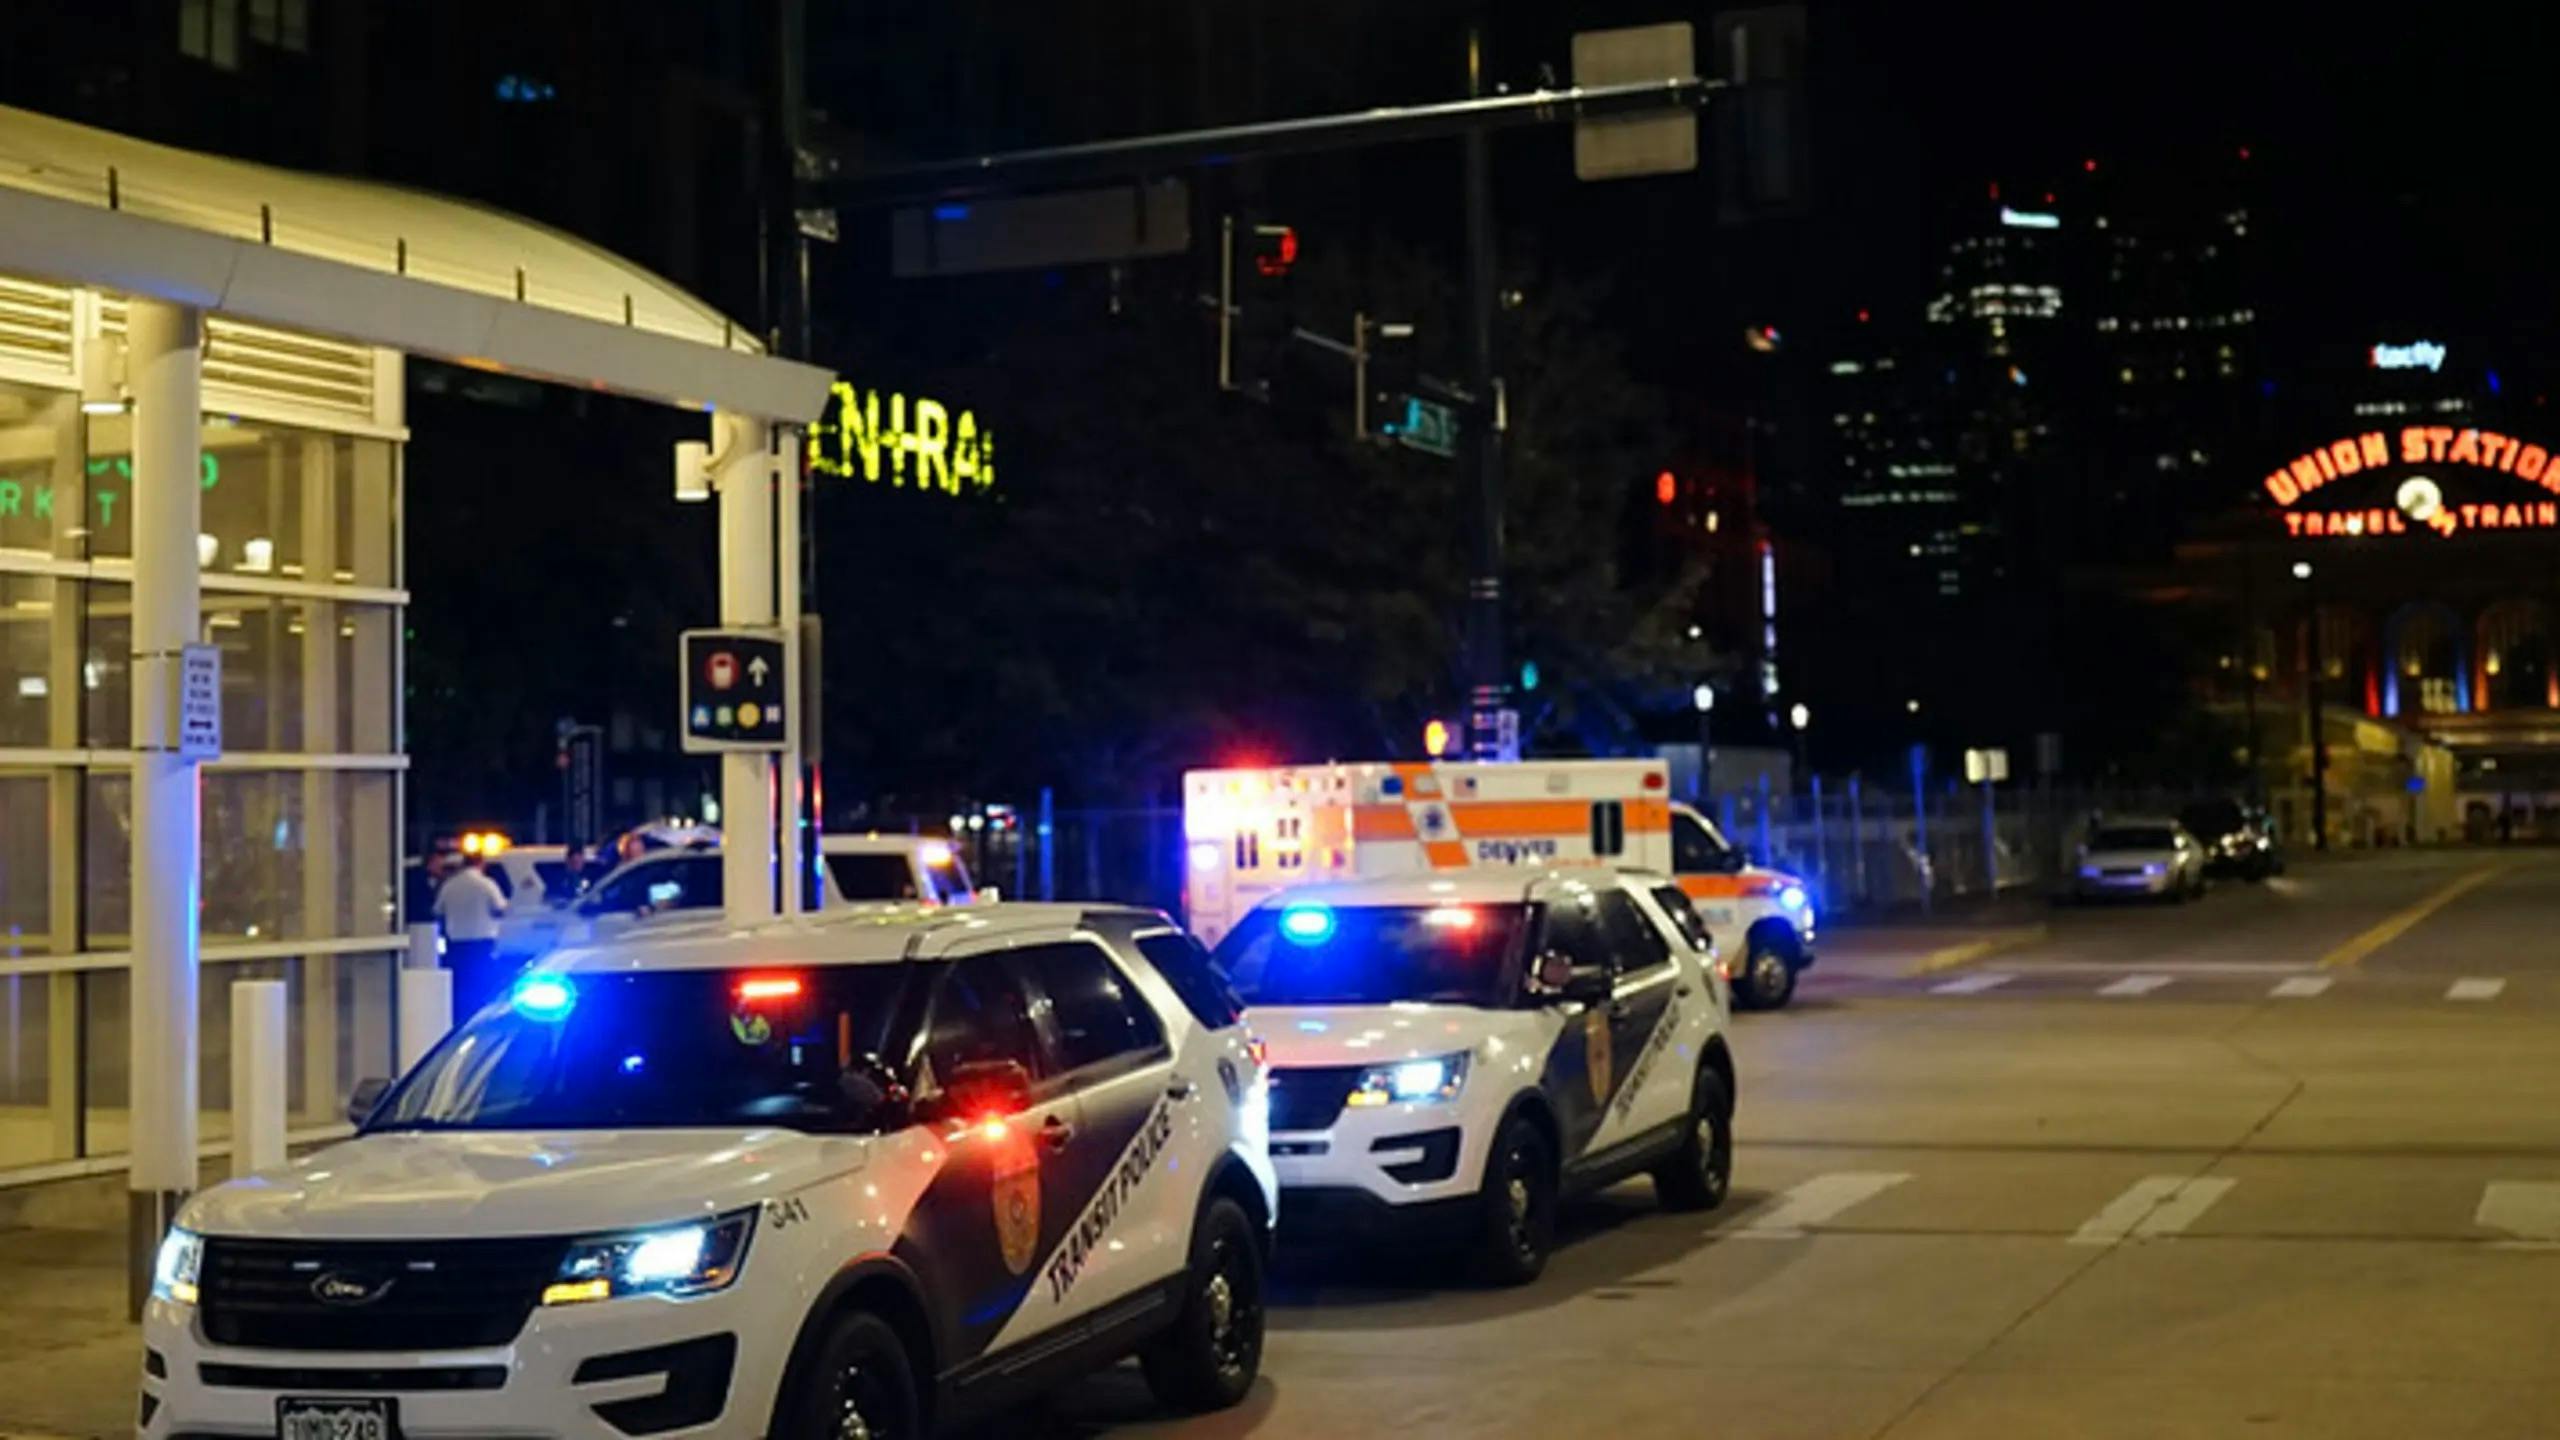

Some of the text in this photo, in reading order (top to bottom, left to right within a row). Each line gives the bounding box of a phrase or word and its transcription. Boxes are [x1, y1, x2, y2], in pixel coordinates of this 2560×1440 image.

[2264, 424, 2560, 507] UNION STATION
[2461, 501, 2557, 529] TRAIN
[1047, 1102, 1172, 1305] TRANSIT POLICE
